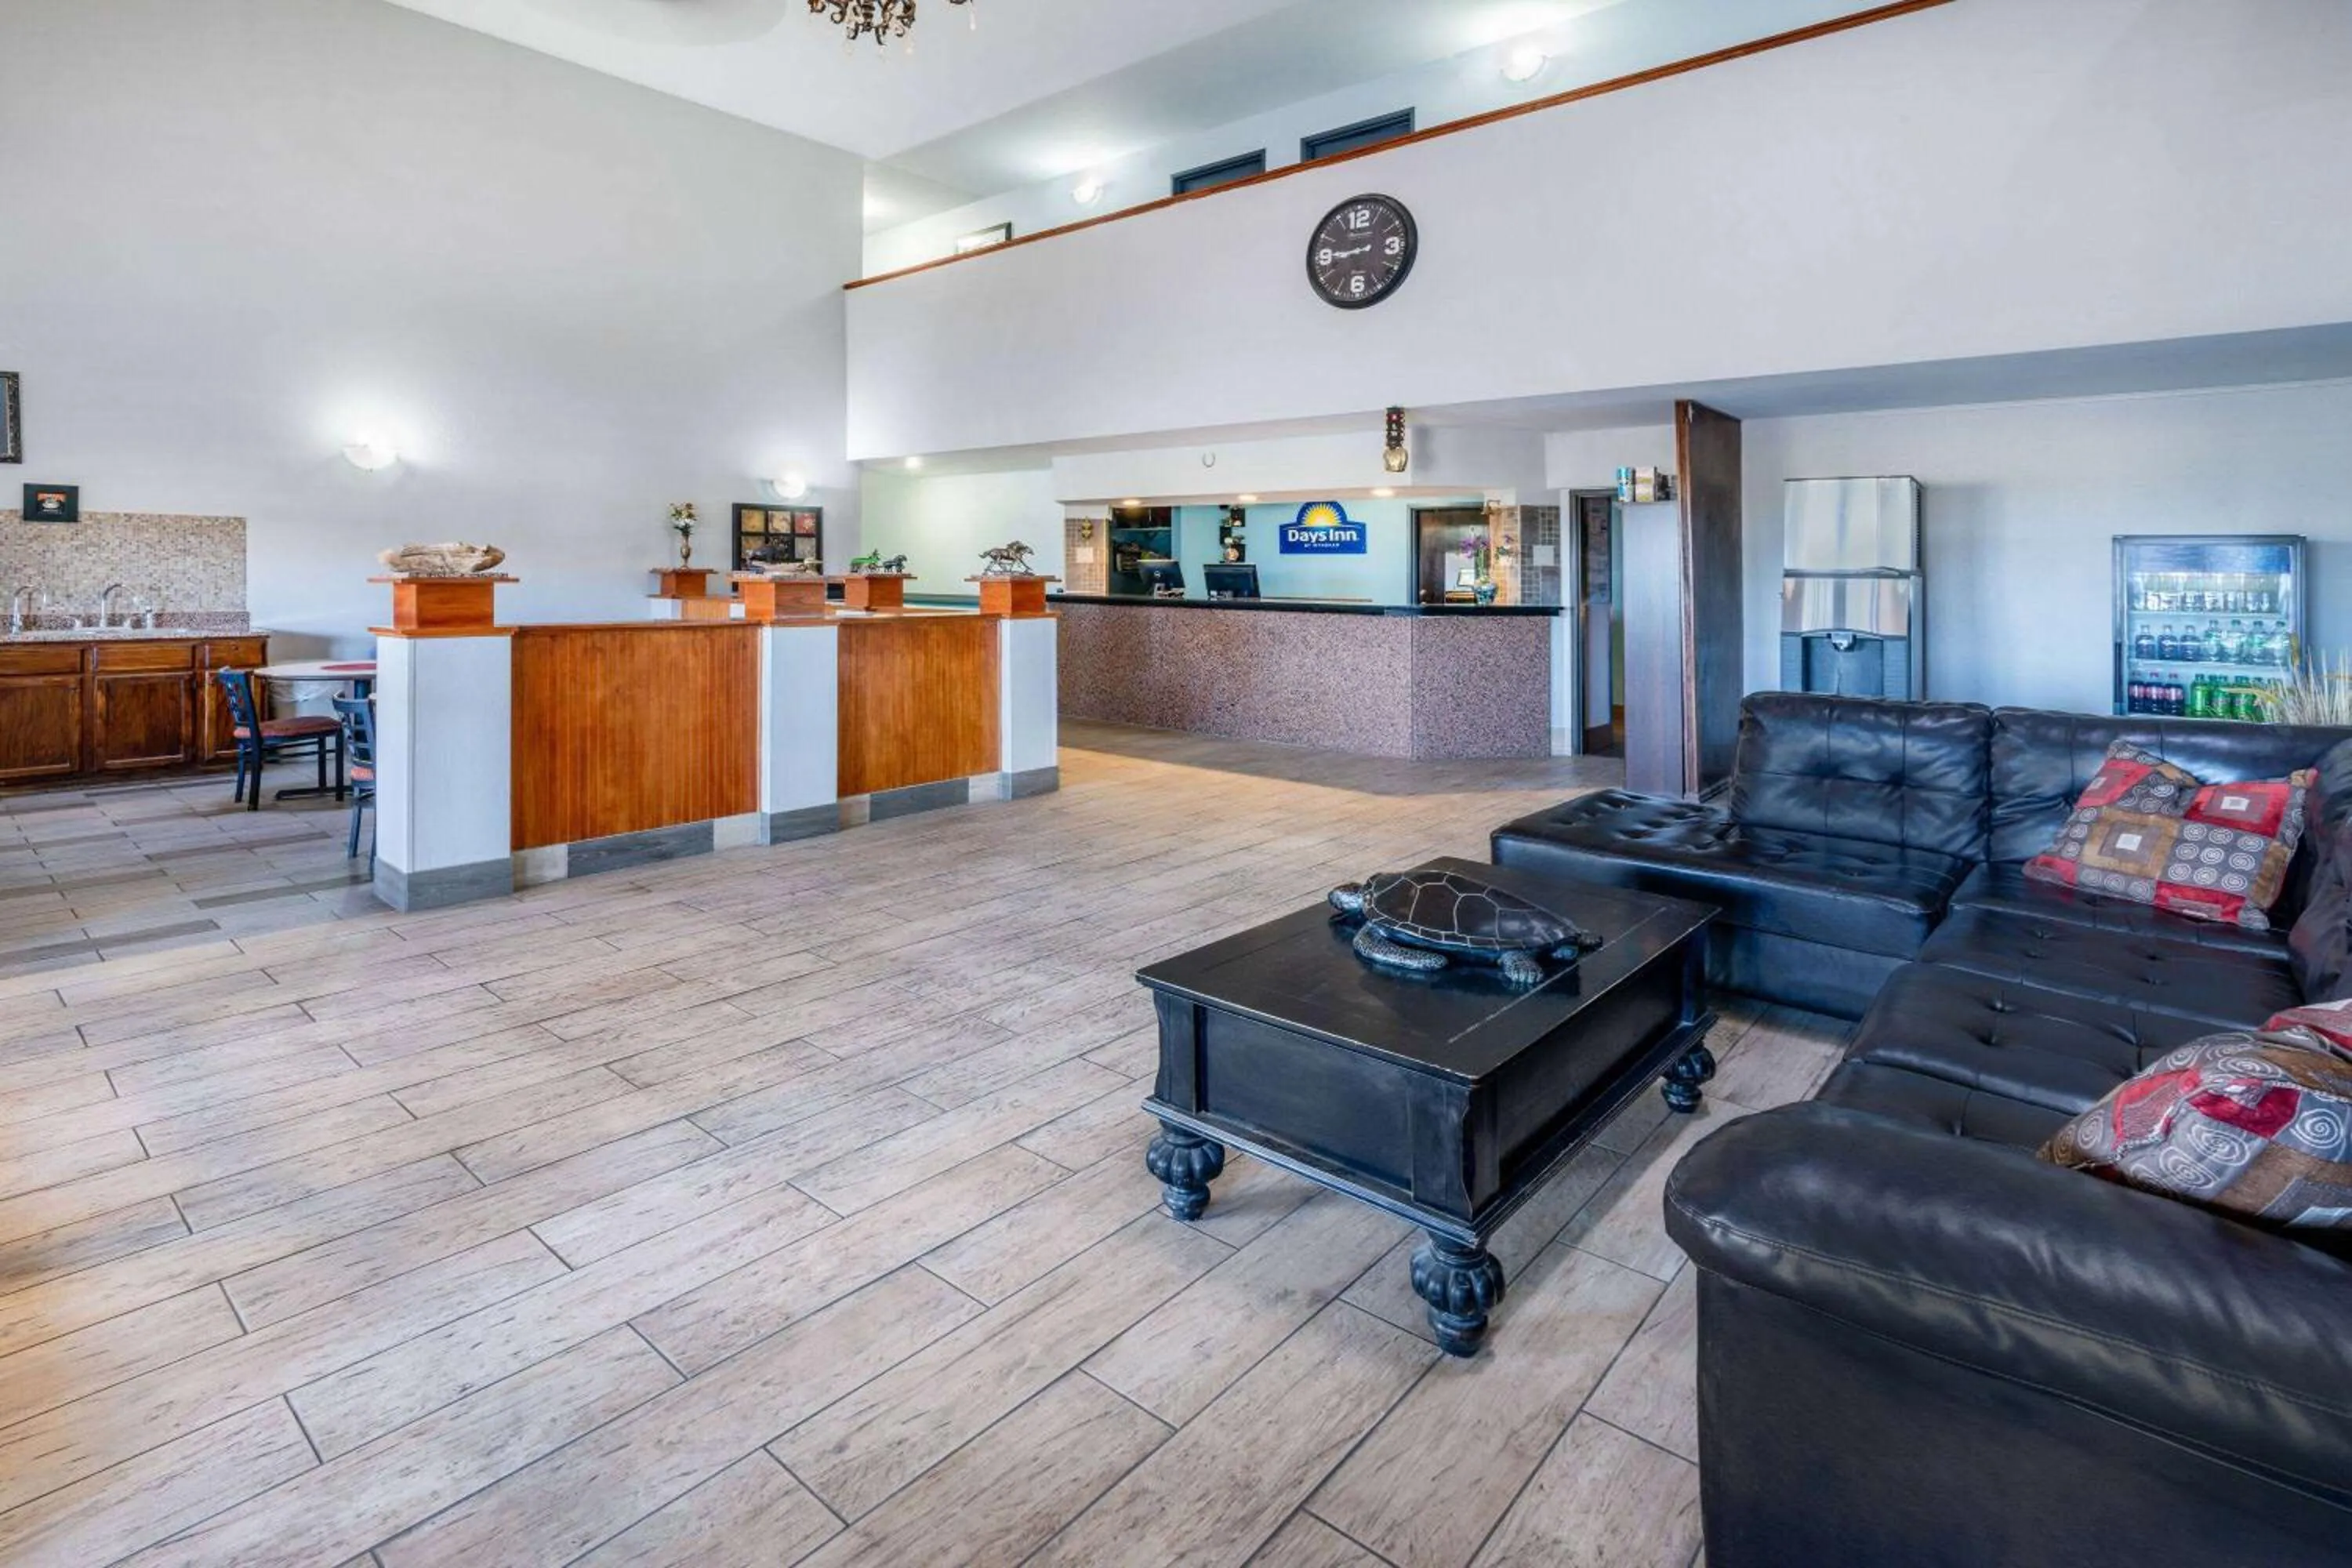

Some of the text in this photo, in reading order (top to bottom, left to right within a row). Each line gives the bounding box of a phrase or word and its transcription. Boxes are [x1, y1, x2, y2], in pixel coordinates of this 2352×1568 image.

[1348, 209, 1370, 230] 12
[1384, 237, 1399, 255] 3
[1319, 248, 1332, 266] 9
[1350, 275, 1365, 293] 6
[1288, 528, 1357, 543] Days Inn
